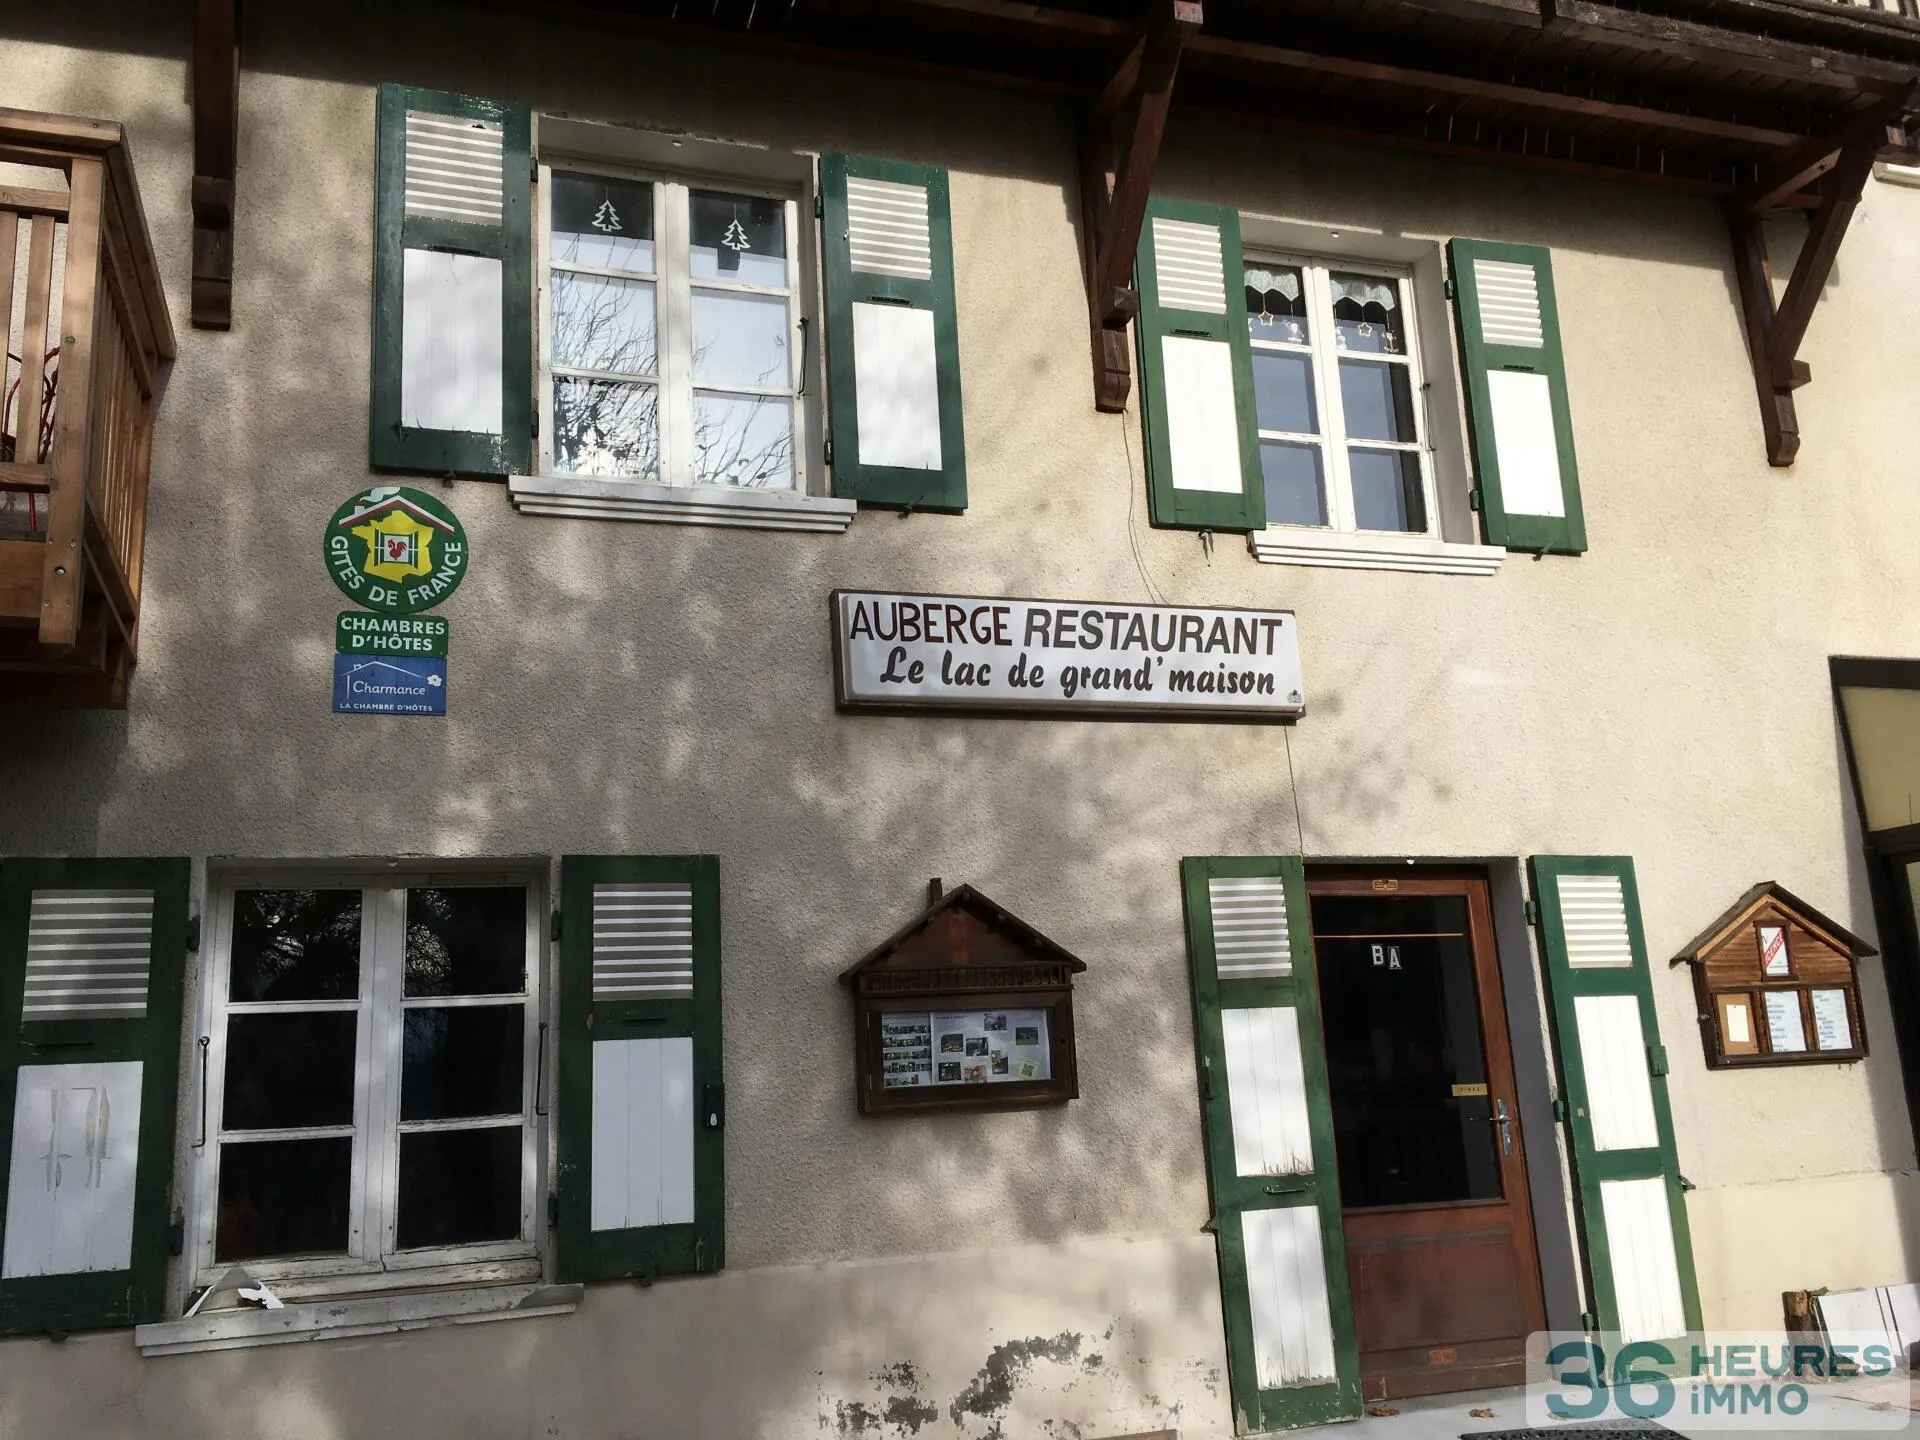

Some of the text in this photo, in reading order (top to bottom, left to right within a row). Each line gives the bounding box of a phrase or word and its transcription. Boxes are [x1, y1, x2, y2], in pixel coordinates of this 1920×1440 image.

[368, 586, 398, 606] DE
[407, 542, 462, 605] FRANCE
[340, 617, 445, 635] CHAMBRES
[850, 600, 1283, 656] AUBERGE RESTAURANT
[352, 633, 433, 651] D'HÔTES
[880, 646, 1276, 698] Le lac de grand' maison
[352, 680, 426, 696] Charmance
[353, 703, 394, 711] CHAMBRE
[1763, 929, 1784, 966] ICENCE
